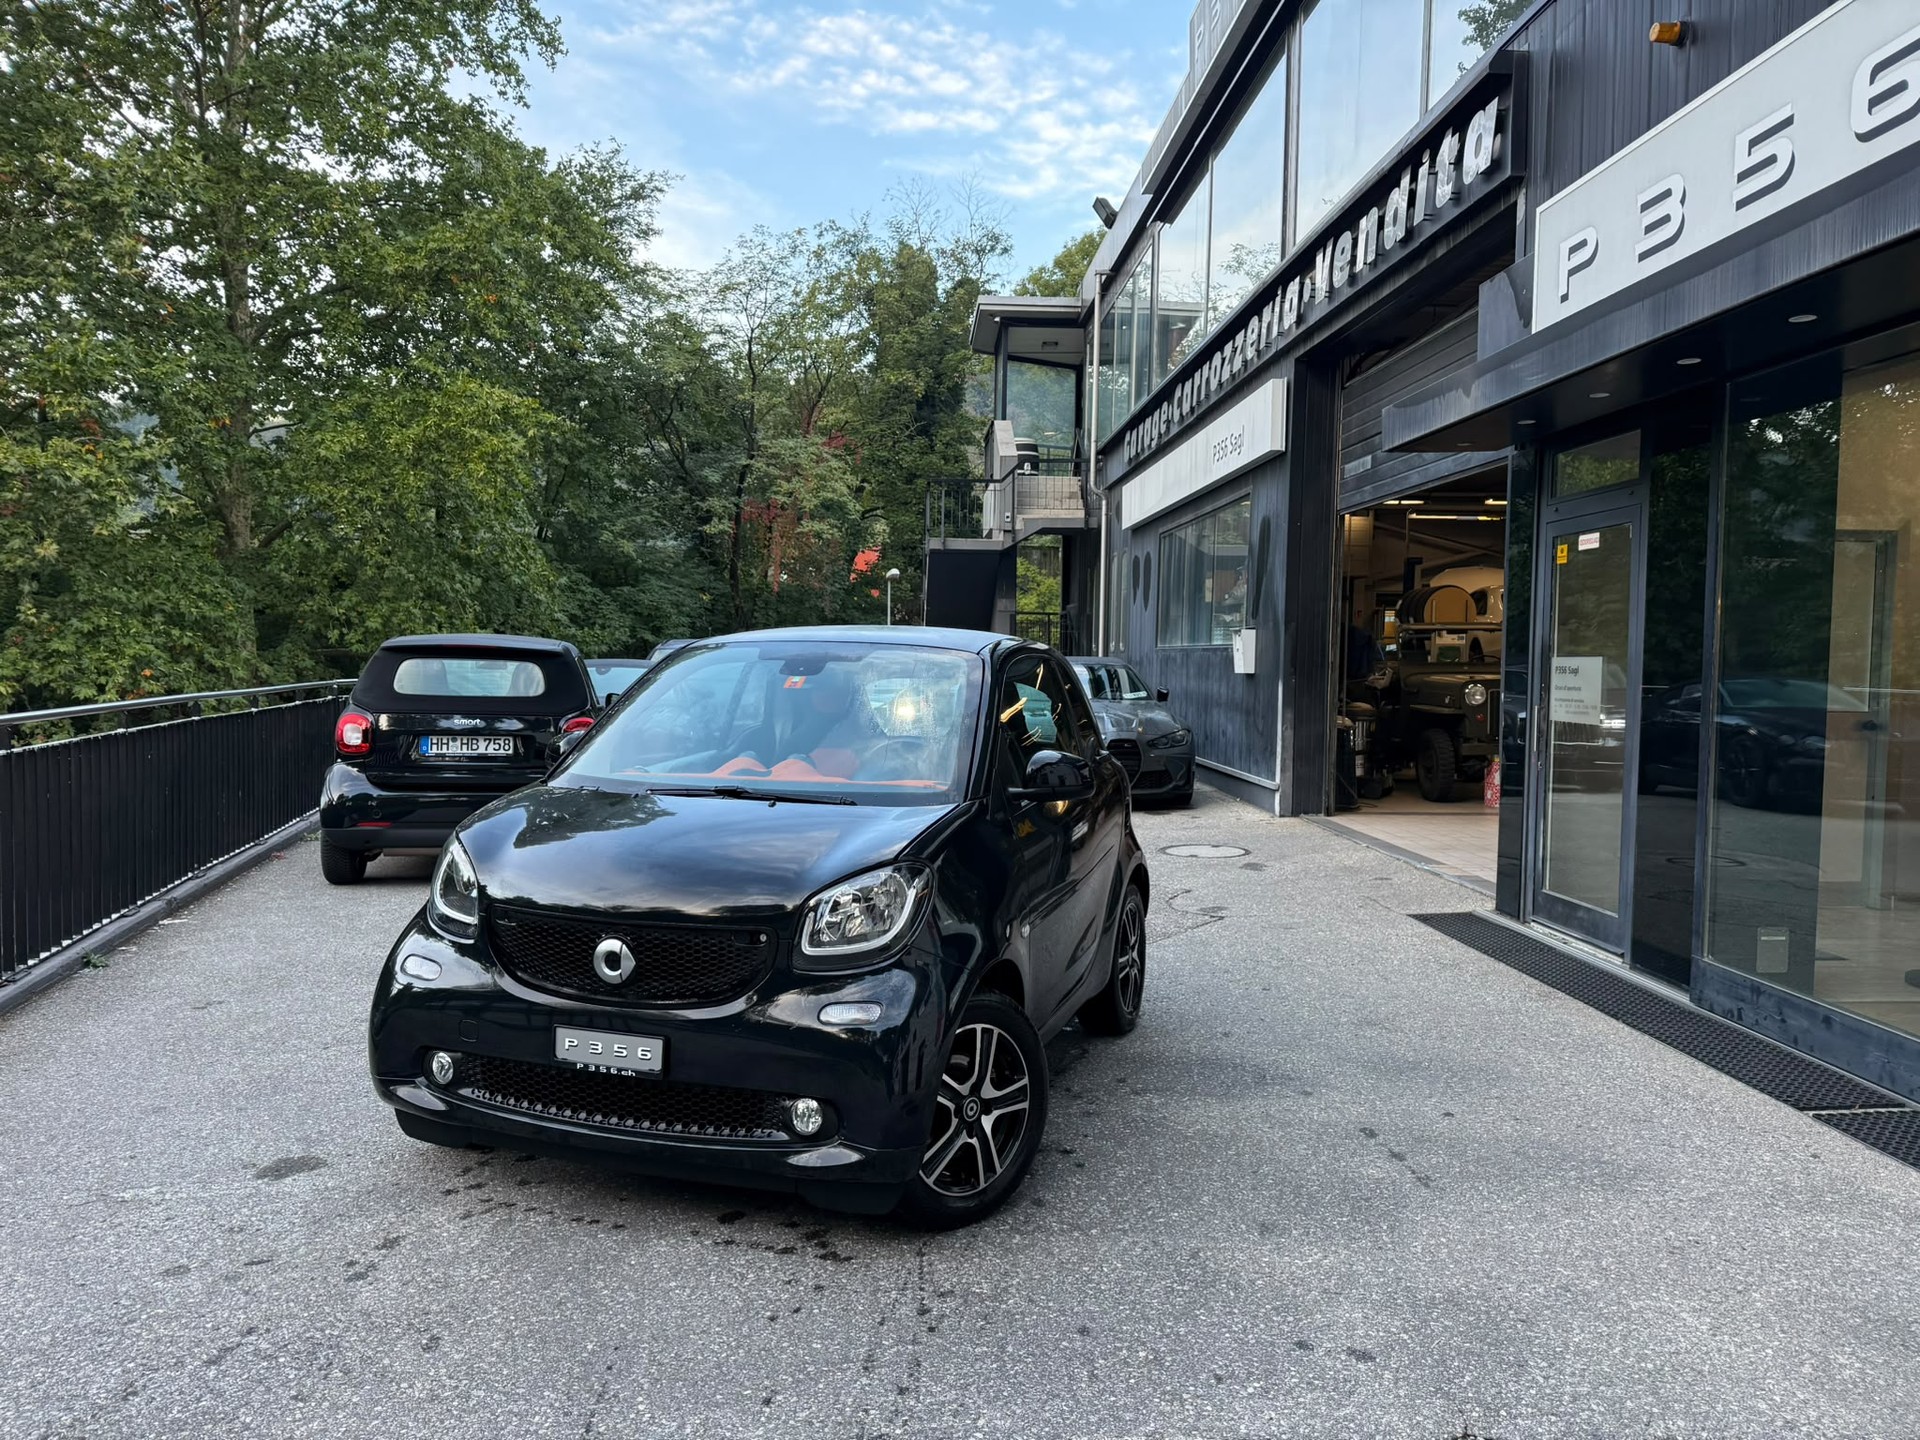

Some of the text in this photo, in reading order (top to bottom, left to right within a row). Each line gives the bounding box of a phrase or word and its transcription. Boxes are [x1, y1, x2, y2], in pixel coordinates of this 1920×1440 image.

[1558, 25, 1920, 304] P356
[1213, 424, 1245, 465] P356 Sagl
[1555, 665, 1567, 675] P356
[483, 738, 511, 752] 758
[564, 1038, 652, 1061] P356
